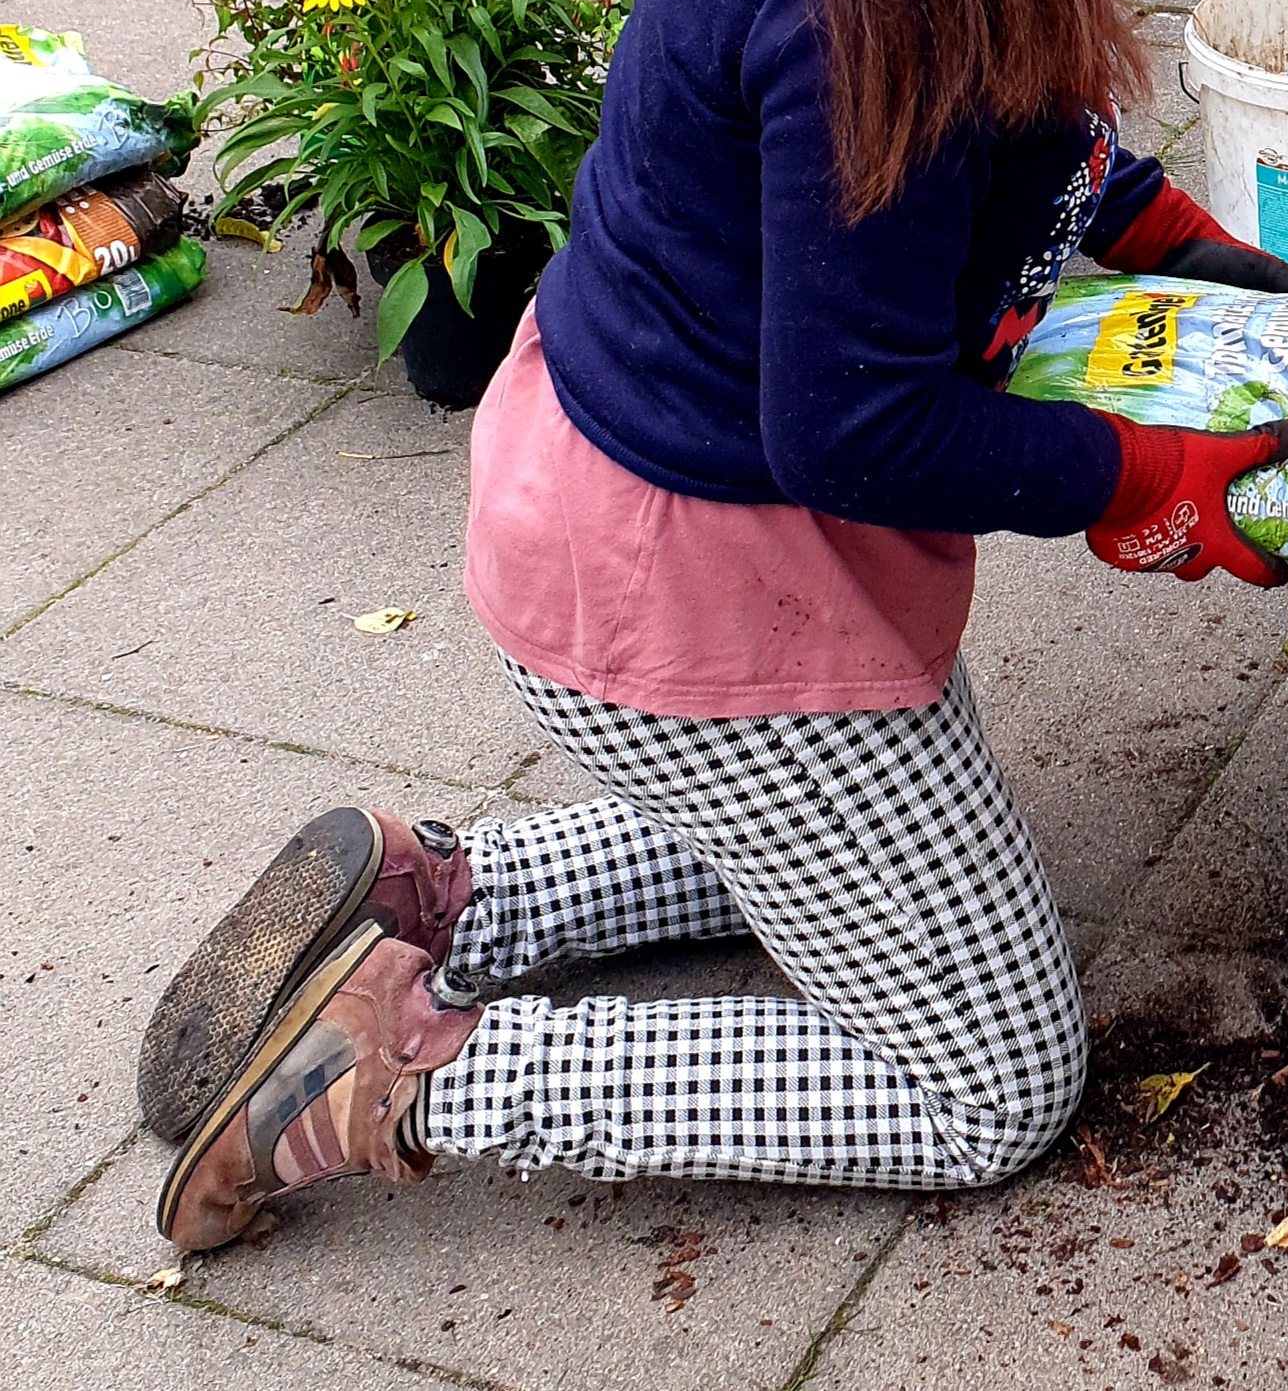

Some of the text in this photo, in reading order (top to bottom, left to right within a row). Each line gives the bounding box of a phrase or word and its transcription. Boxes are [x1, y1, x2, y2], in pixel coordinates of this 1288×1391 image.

[28, 145, 74, 175] Gemüse
[71, 132, 98, 155] Erde
[56, 289, 113, 339] Bio
[28, 323, 55, 350] Erde
[1226, 494, 1261, 516] und
